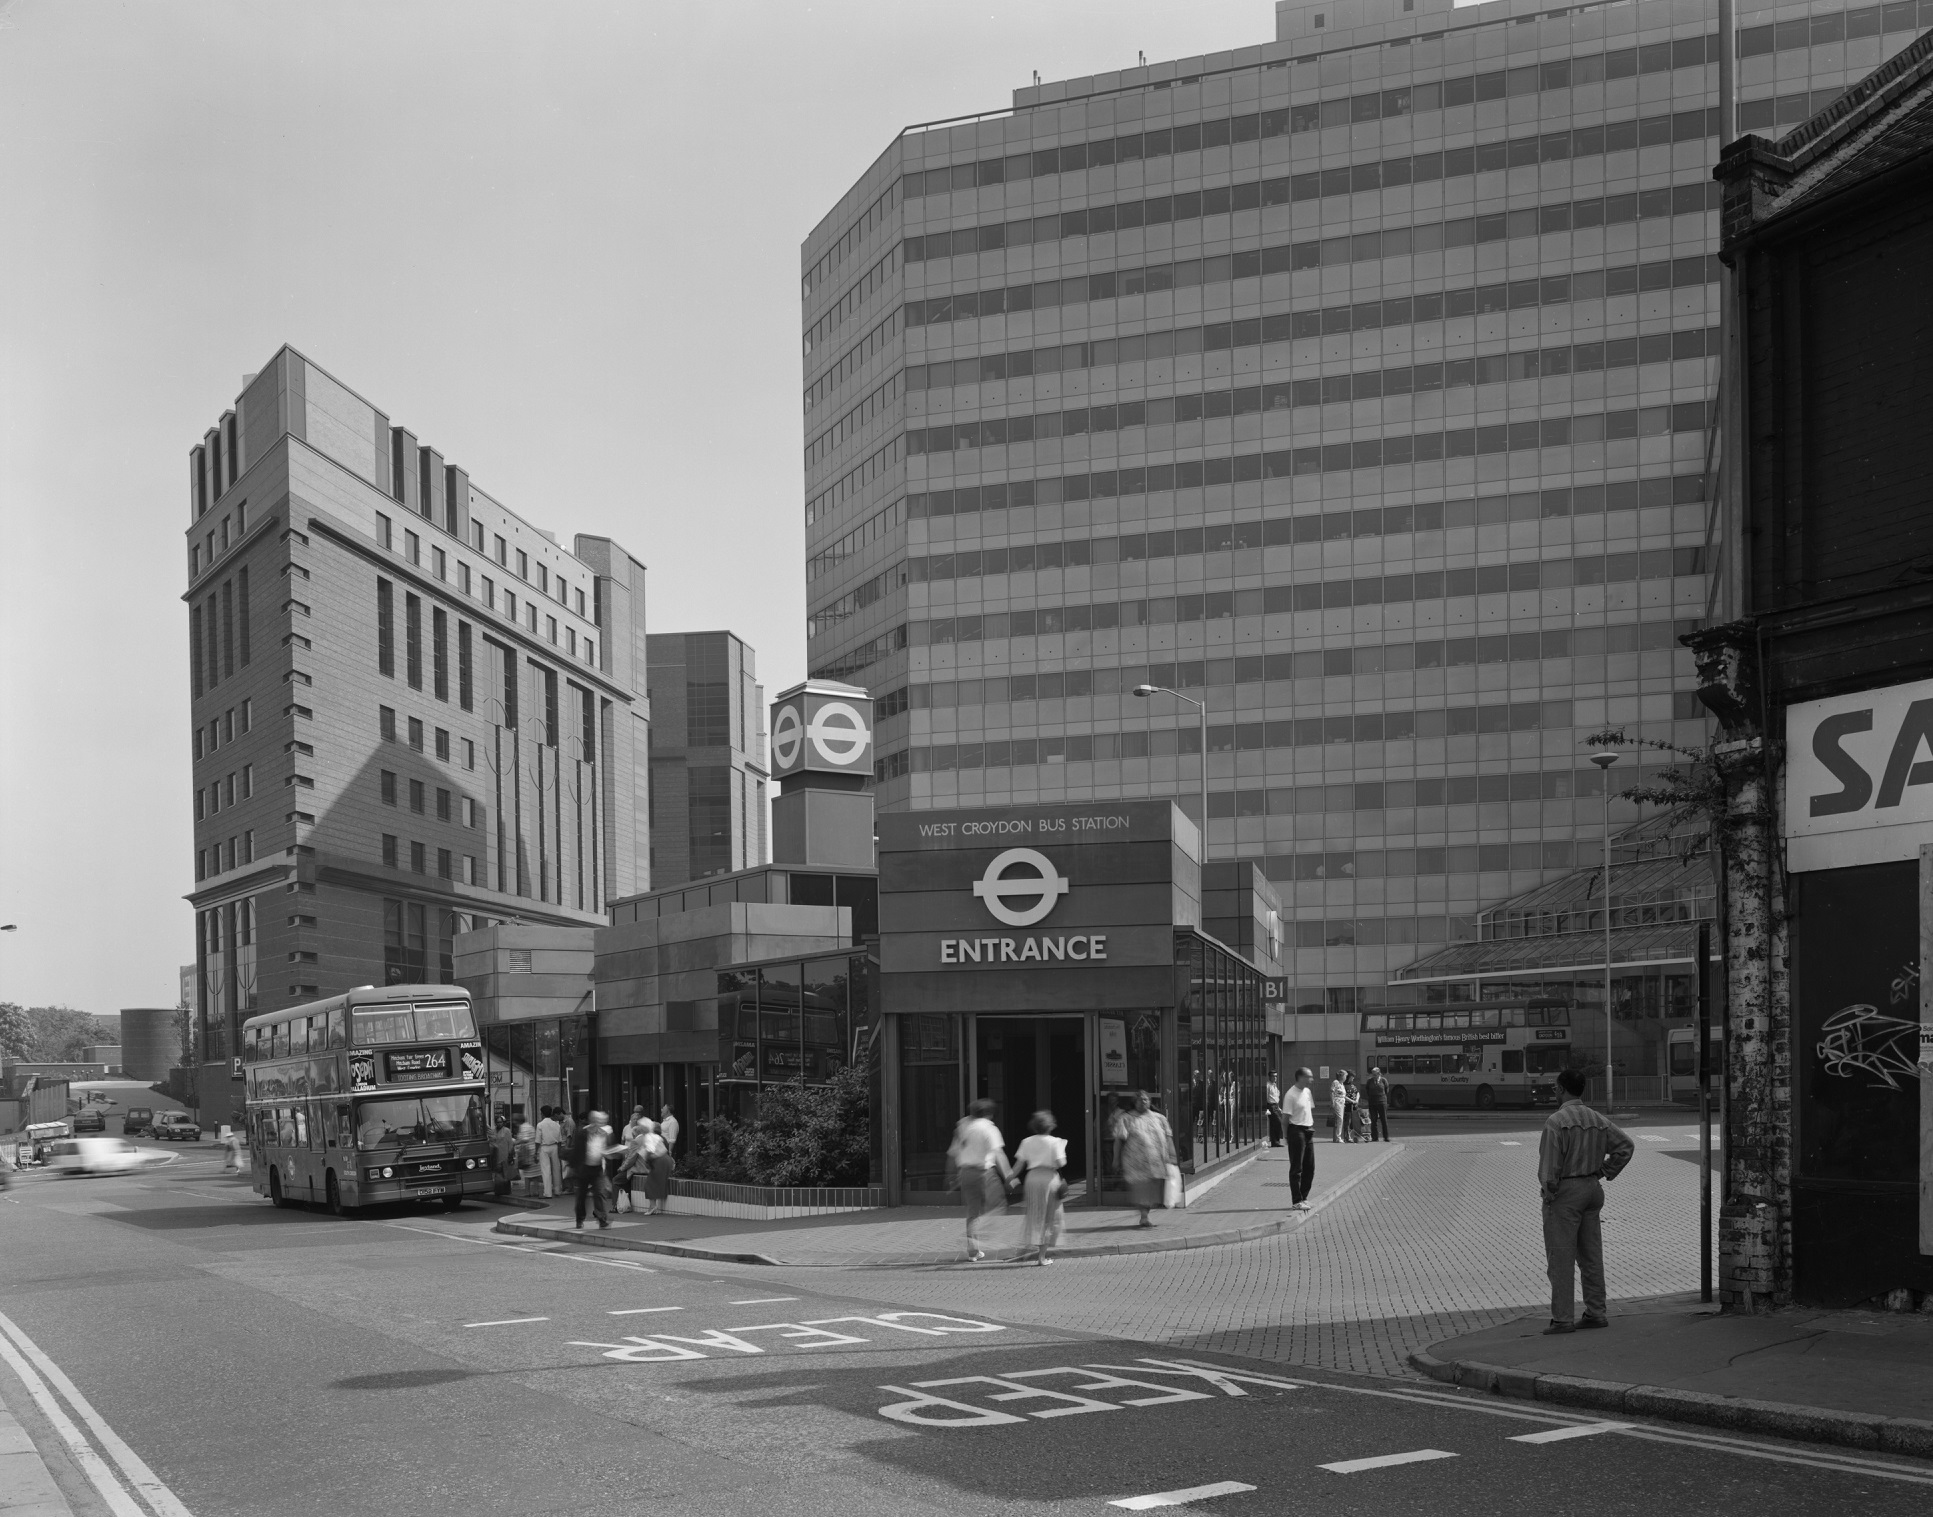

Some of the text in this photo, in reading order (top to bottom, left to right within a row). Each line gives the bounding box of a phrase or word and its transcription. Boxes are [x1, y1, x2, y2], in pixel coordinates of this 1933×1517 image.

[919, 816, 1130, 837] WEST CROYDON BUS STATION
[940, 934, 1108, 964] ENTRANCE
[1395, 1035, 1411, 1044] Henry
[1411, 1034, 1442, 1043] Worthington's
[1461, 1033, 1478, 1042] British
[1479, 1032, 1490, 1040] best
[1490, 1032, 1505, 1040] bitter
[234, 1058, 241, 1072] P
[424, 1053, 446, 1068] 264
[1450, 1075, 1469, 1084] Country
[567, 1311, 1006, 1362] CLEAR
[877, 1358, 1304, 1427] KEEP
